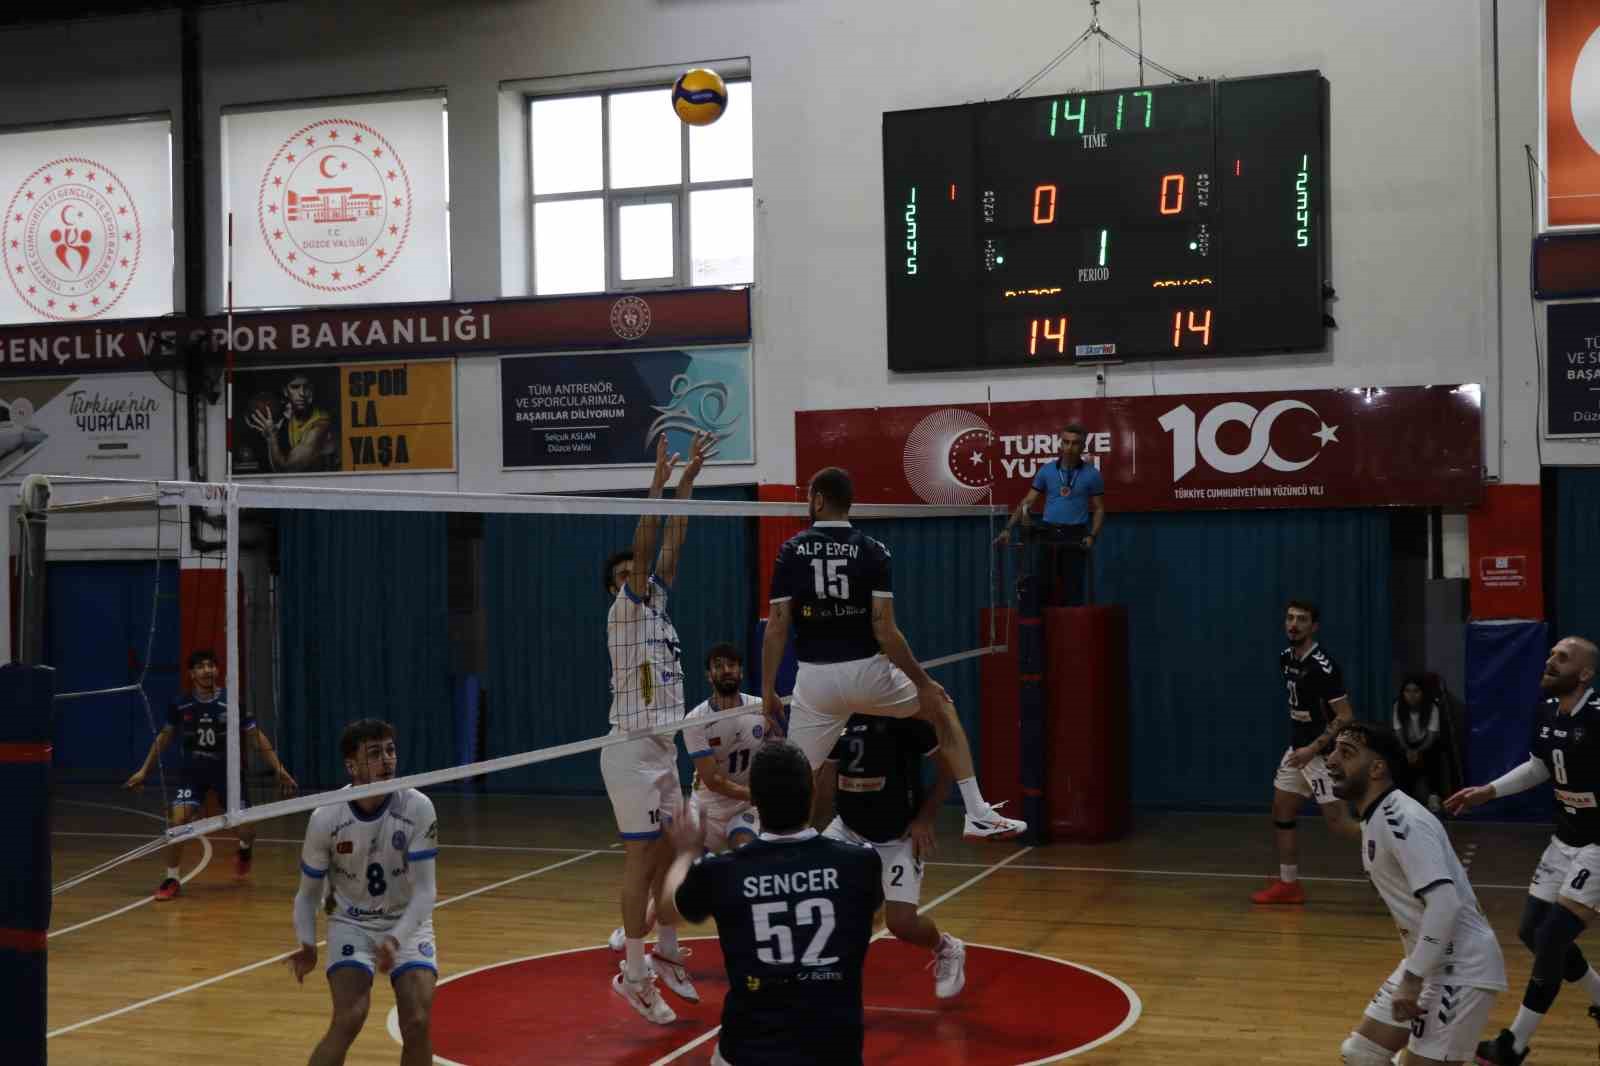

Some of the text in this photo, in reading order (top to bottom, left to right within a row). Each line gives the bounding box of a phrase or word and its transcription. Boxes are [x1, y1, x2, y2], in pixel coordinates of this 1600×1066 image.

[1049, 88, 1153, 137] 14 17
[1080, 132, 1108, 150] TIME
[1033, 184, 1058, 225] 0
[1159, 174, 1185, 216] 0
[1098, 229, 1109, 267] 1
[1078, 268, 1110, 283] PERIOD
[0, 328, 126, 366] ENÇLİK
[291, 309, 491, 350] BAKANLIĞI
[1029, 318, 1067, 356] 14
[1173, 309, 1213, 348] 14
[1567, 352, 1584, 364] VE
[515, 397, 530, 408] VE
[528, 383, 552, 396] TÜM
[76, 413, 150, 432] YURTLARI
[351, 400, 379, 428] LA
[349, 433, 410, 468] YAŞA
[796, 541, 859, 560] ALP EREN
[809, 558, 850, 600] 15
[197, 727, 217, 747] 20
[847, 738, 866, 773] 2
[175, 788, 193, 800] 20
[367, 862, 387, 897] 8
[742, 867, 840, 898] SENCER
[890, 865, 905, 887] 2
[1570, 868, 1591, 890] 8
[750, 897, 841, 968] 52
[341, 944, 355, 957] 8
